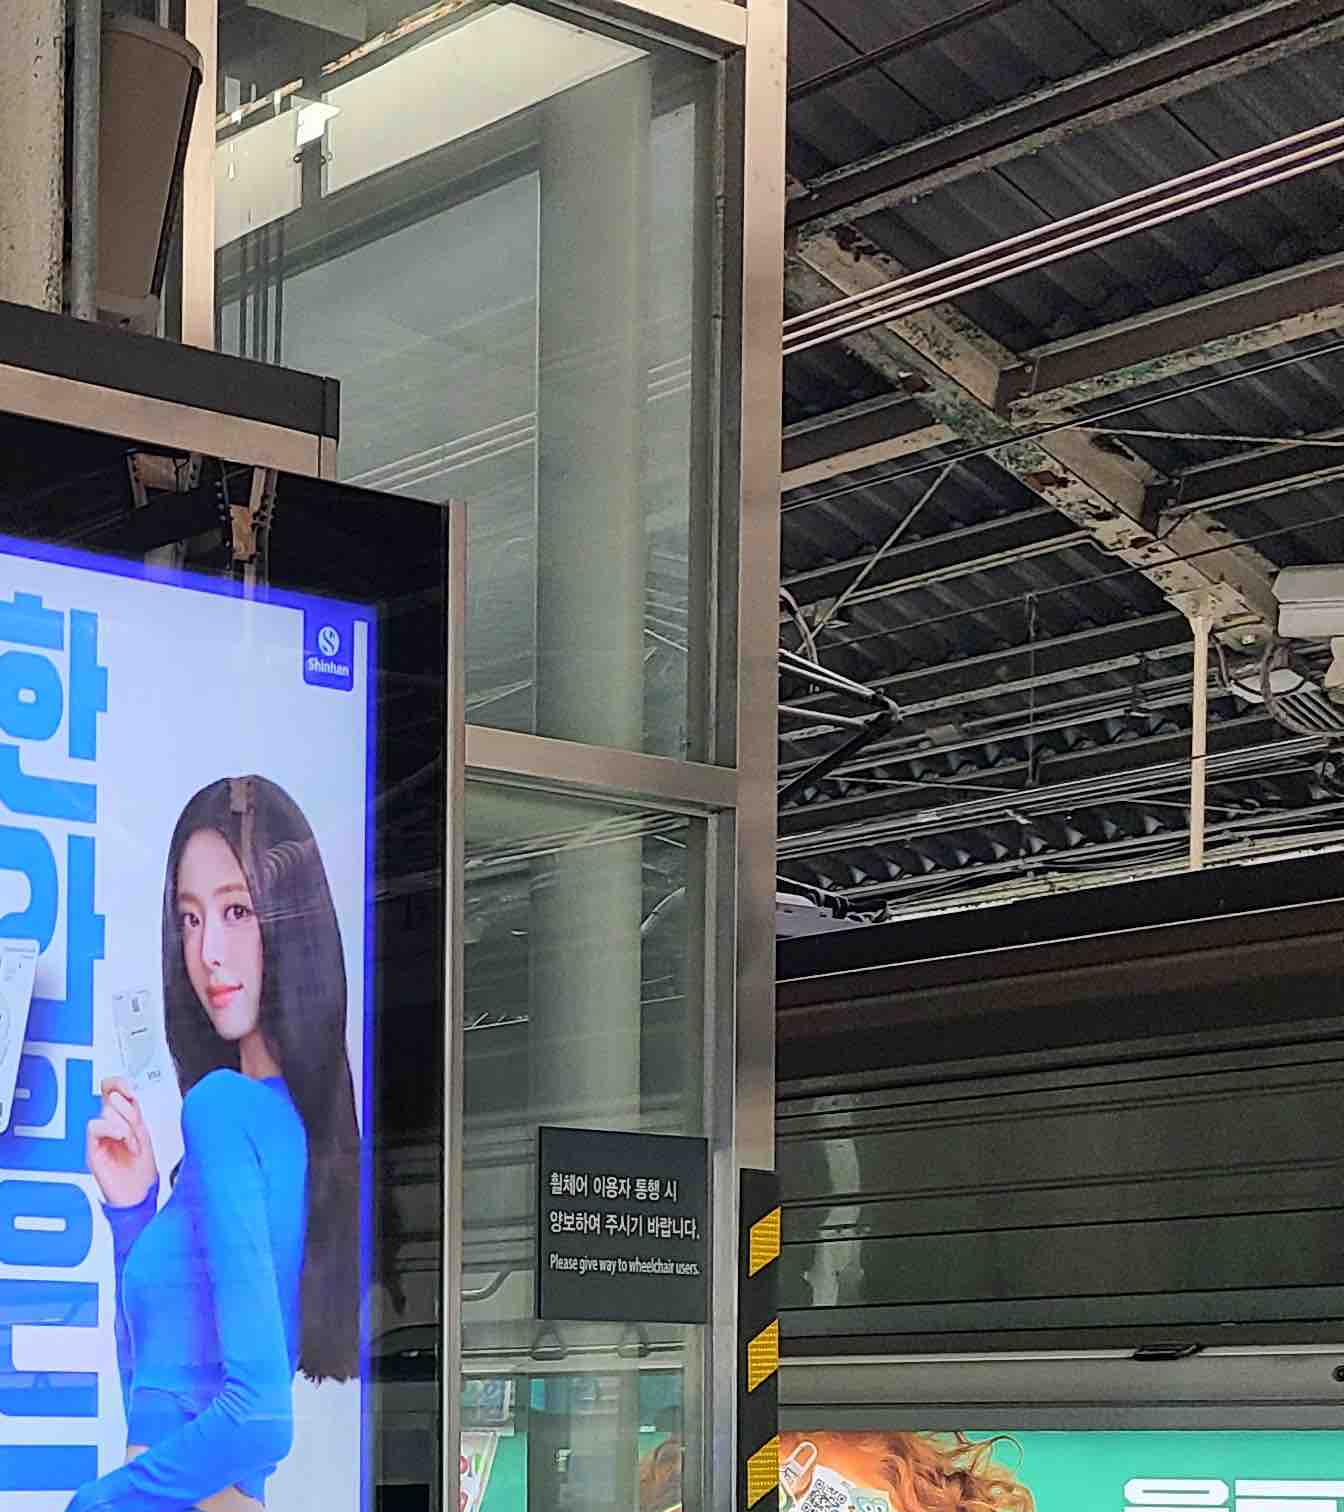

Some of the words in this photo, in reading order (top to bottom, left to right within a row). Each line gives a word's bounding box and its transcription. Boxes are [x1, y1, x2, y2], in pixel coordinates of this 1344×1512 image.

[550, 1172, 588, 1197] 휠체어
[593, 1176, 631, 1199] 이용자
[634, 1179, 660, 1201] 통행
[664, 1180, 678, 1202] 시
[550, 1211, 601, 1236] 양보하여
[605, 1214, 643, 1237] 주시기
[647, 1216, 701, 1240] 바랍니다.
[550, 1253, 578, 1271] Please
[579, 1258, 599, 1275] give
[599, 1260, 616, 1276] way
[618, 1259, 628, 1273] to
[628, 1258, 675, 1275] wheelchair
[676, 1262, 701, 1276] users.
